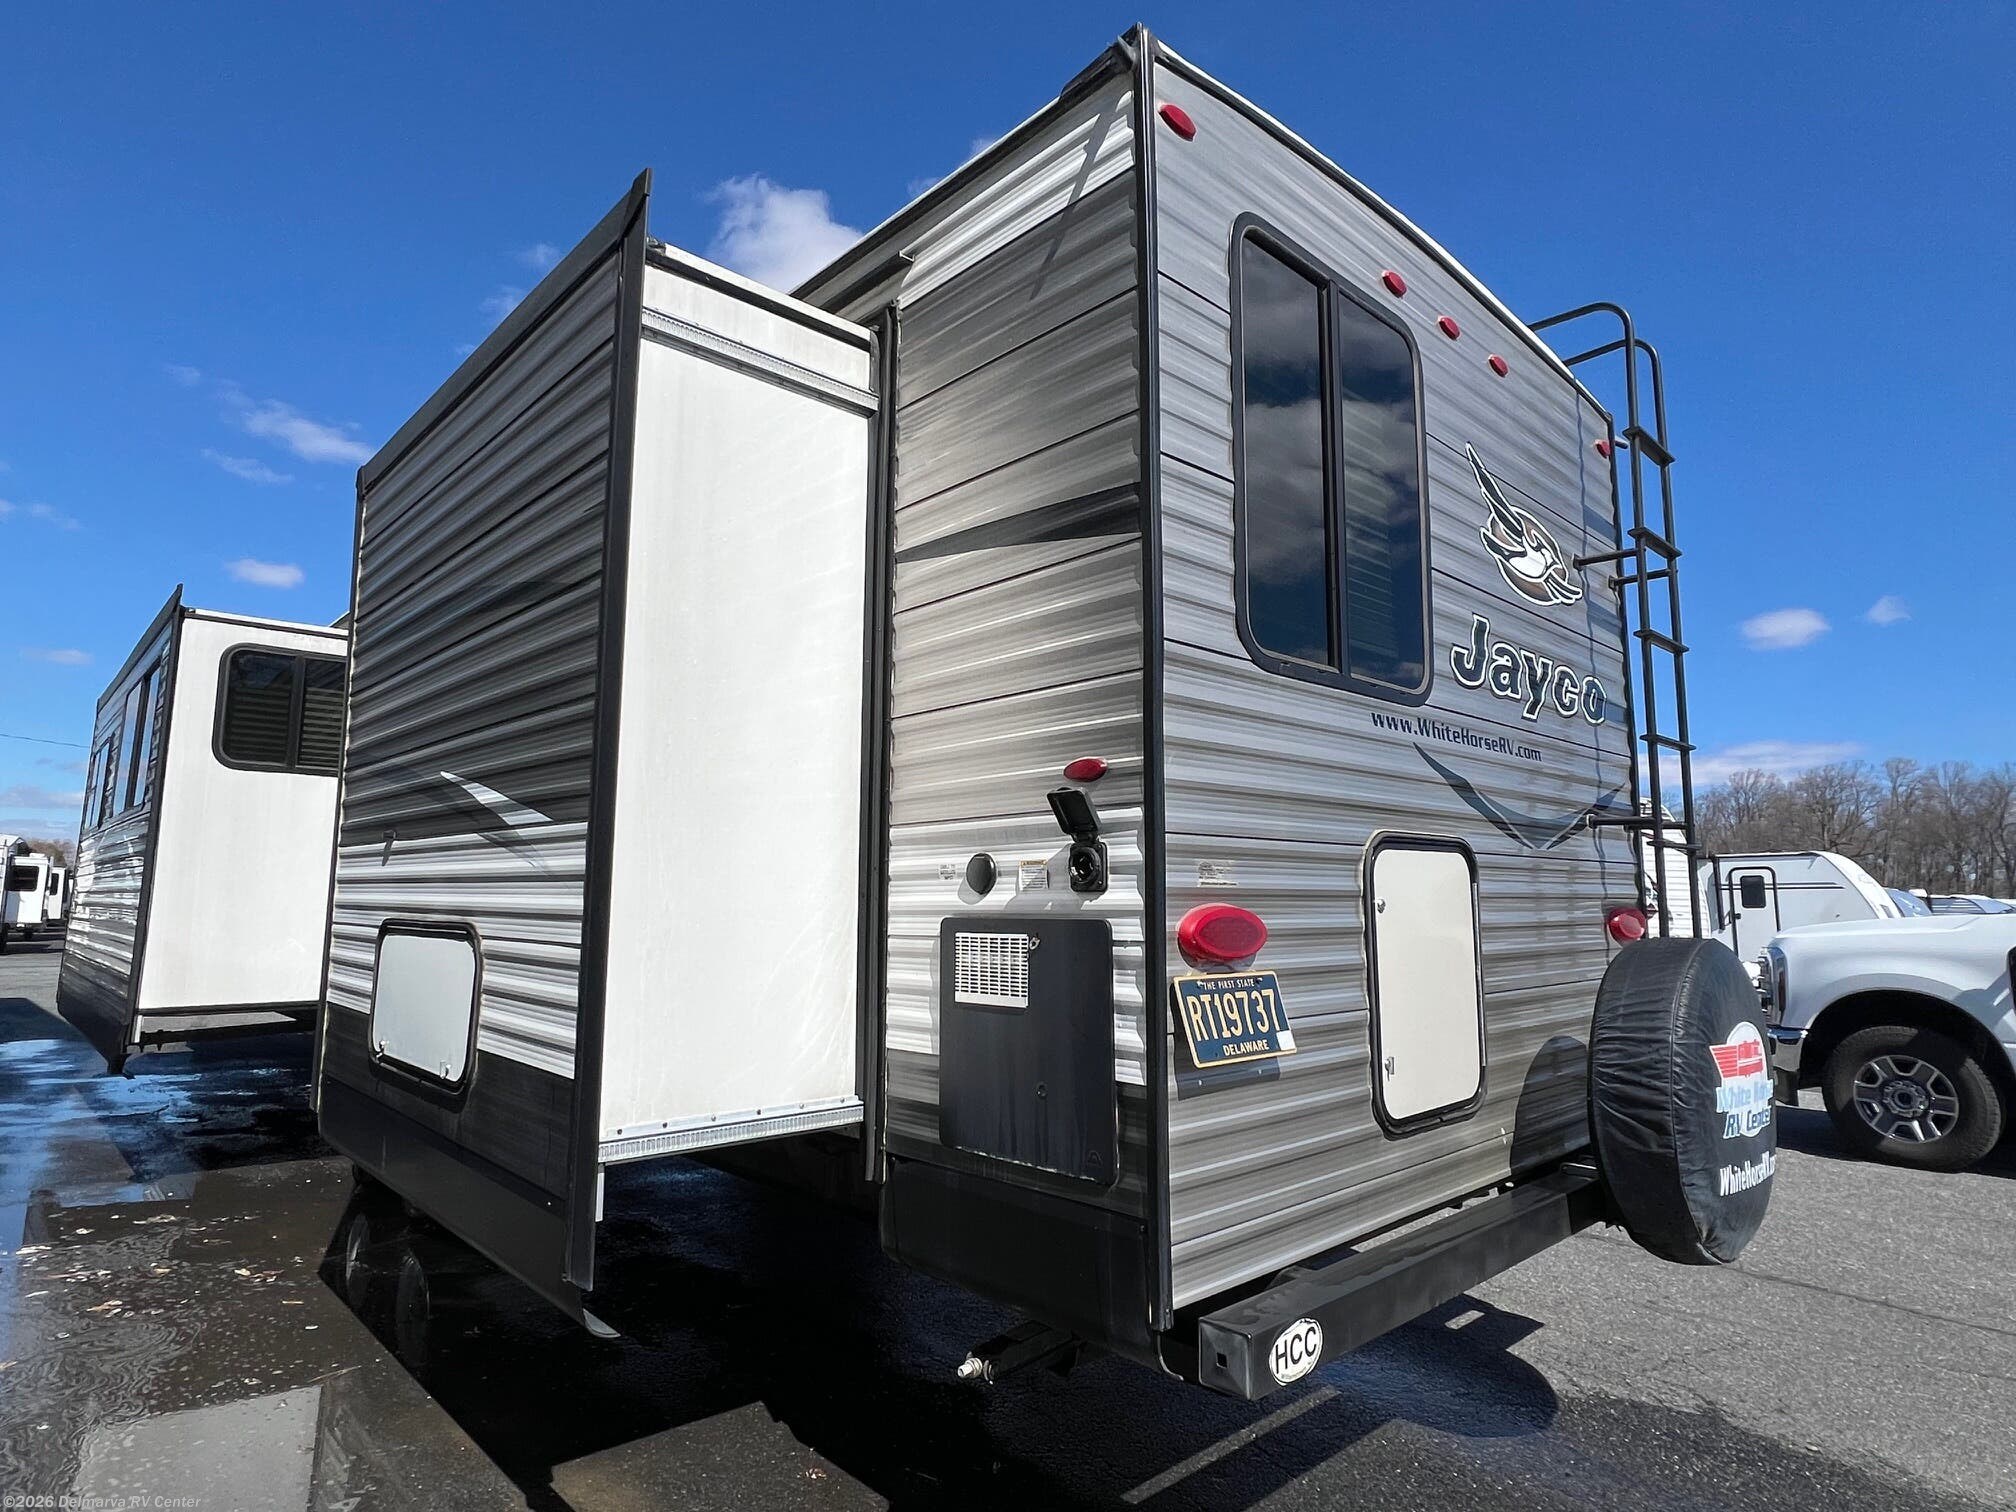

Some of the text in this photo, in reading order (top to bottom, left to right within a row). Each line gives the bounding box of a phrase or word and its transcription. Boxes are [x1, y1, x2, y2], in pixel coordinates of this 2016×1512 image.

[1450, 612, 1607, 725] Jayco
[1370, 711, 1542, 762] www.WhiteHorseRV.com
[1204, 978, 1255, 990] THE FIRST STATE
[1186, 988, 1281, 1042] RT19737
[1222, 1039, 1270, 1057] DELAWARE
[1724, 1112, 1744, 1138] RV
[1275, 1326, 1317, 1374] HCC
